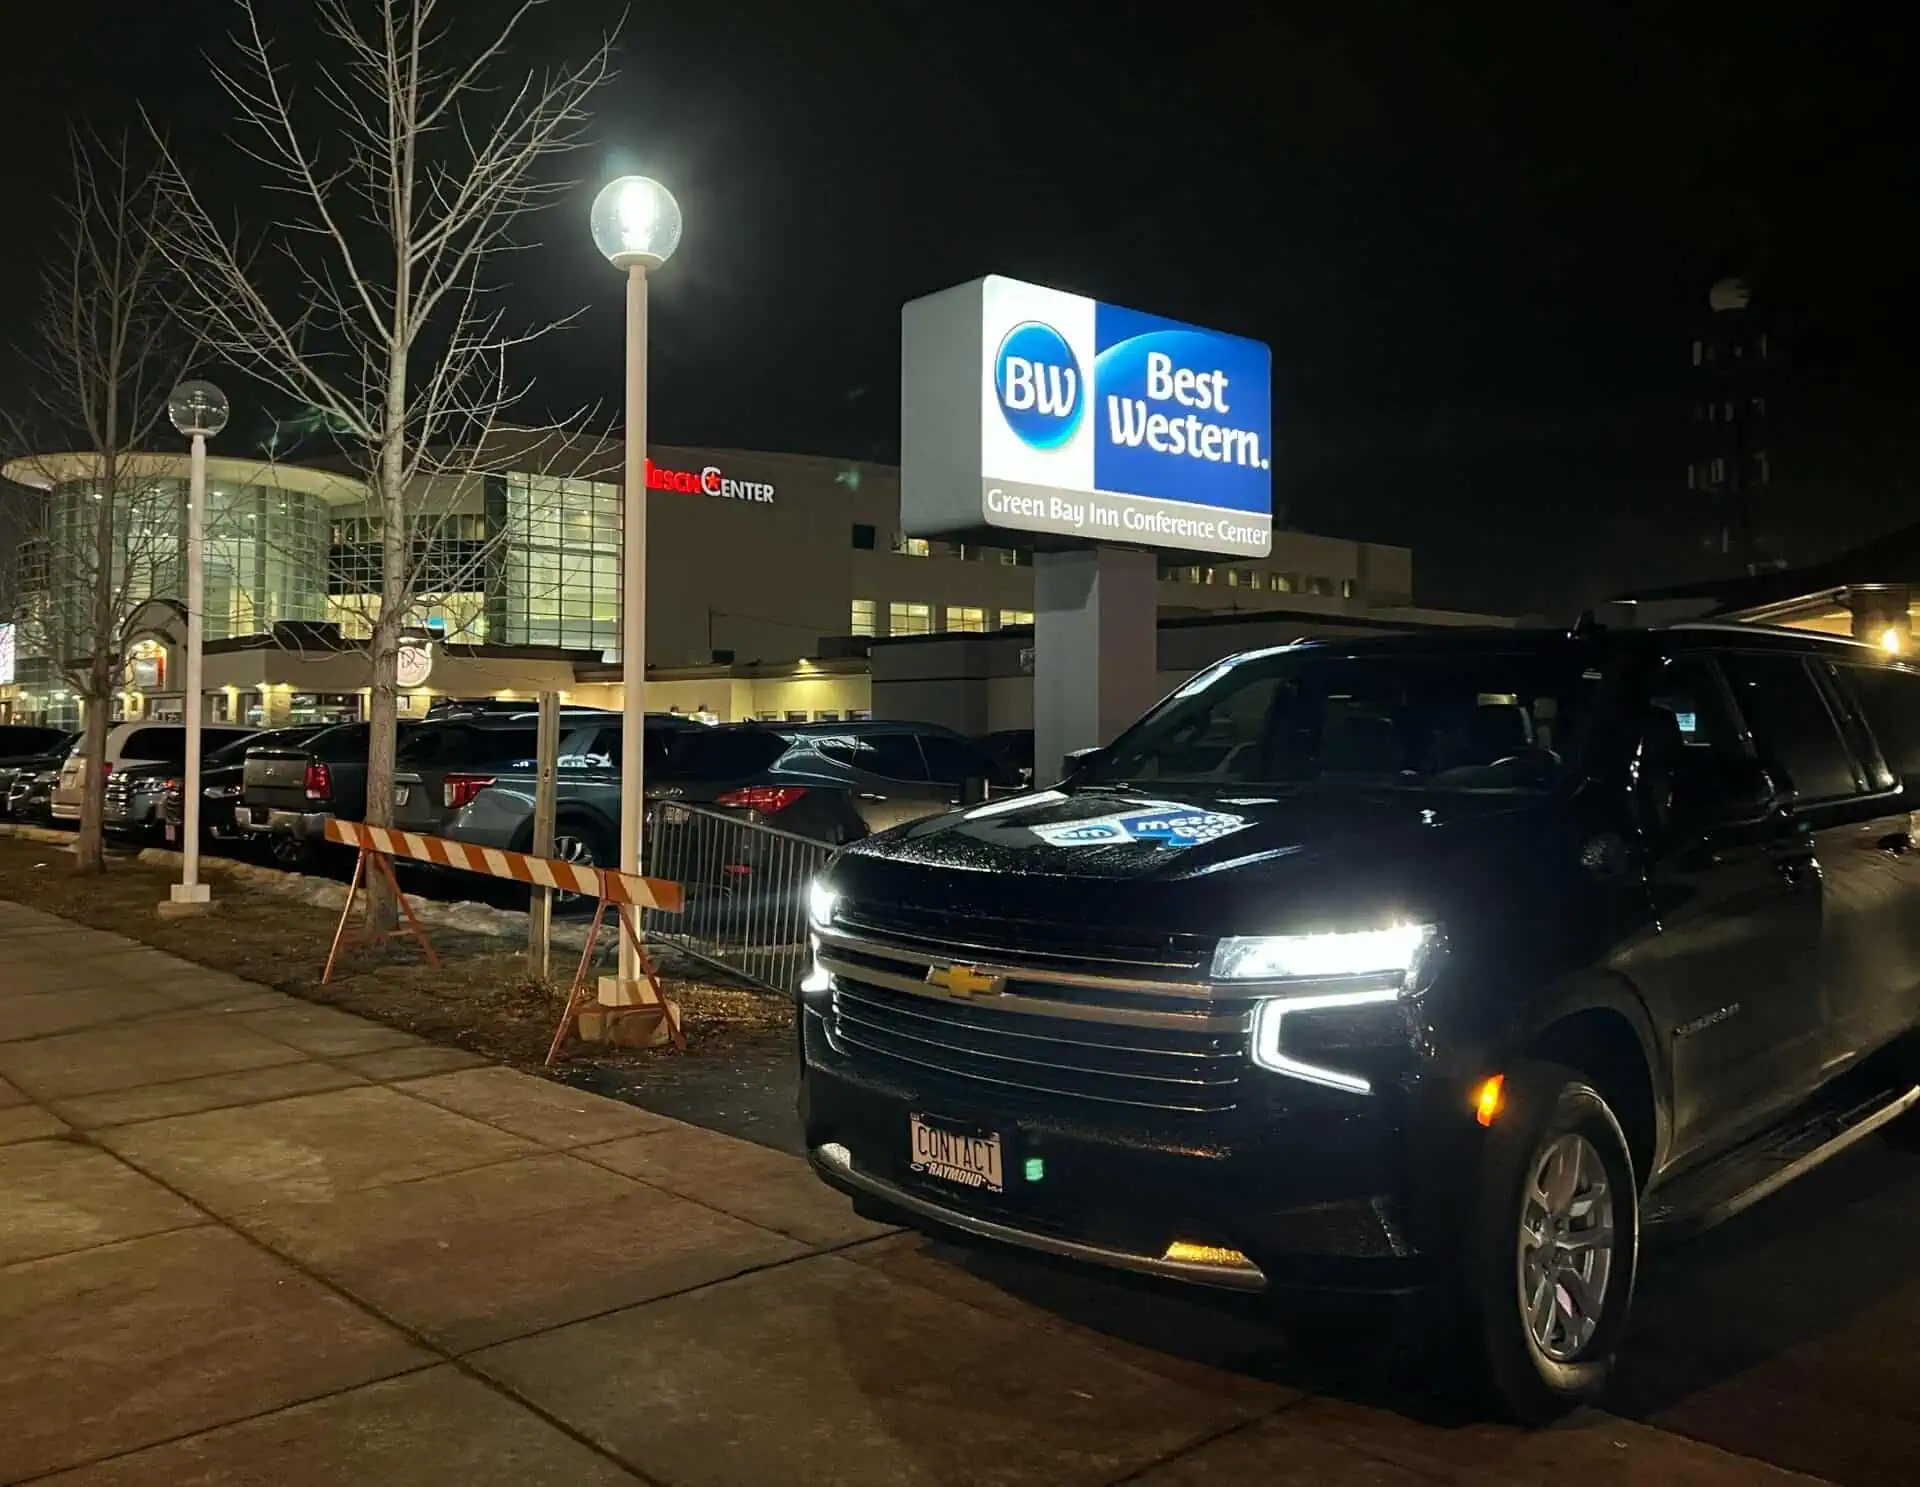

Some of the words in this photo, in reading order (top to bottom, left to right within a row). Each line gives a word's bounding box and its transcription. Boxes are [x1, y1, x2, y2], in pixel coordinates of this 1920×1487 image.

[1005, 357, 1077, 417] BW
[1147, 352, 1230, 413] Best
[988, 489, 1044, 516] Green
[1050, 498, 1084, 527] Bay
[1090, 503, 1120, 527] Inn
[1124, 509, 1215, 539] Conference
[1218, 521, 1269, 545] Center
[918, 1126, 995, 1175] CONTACT
